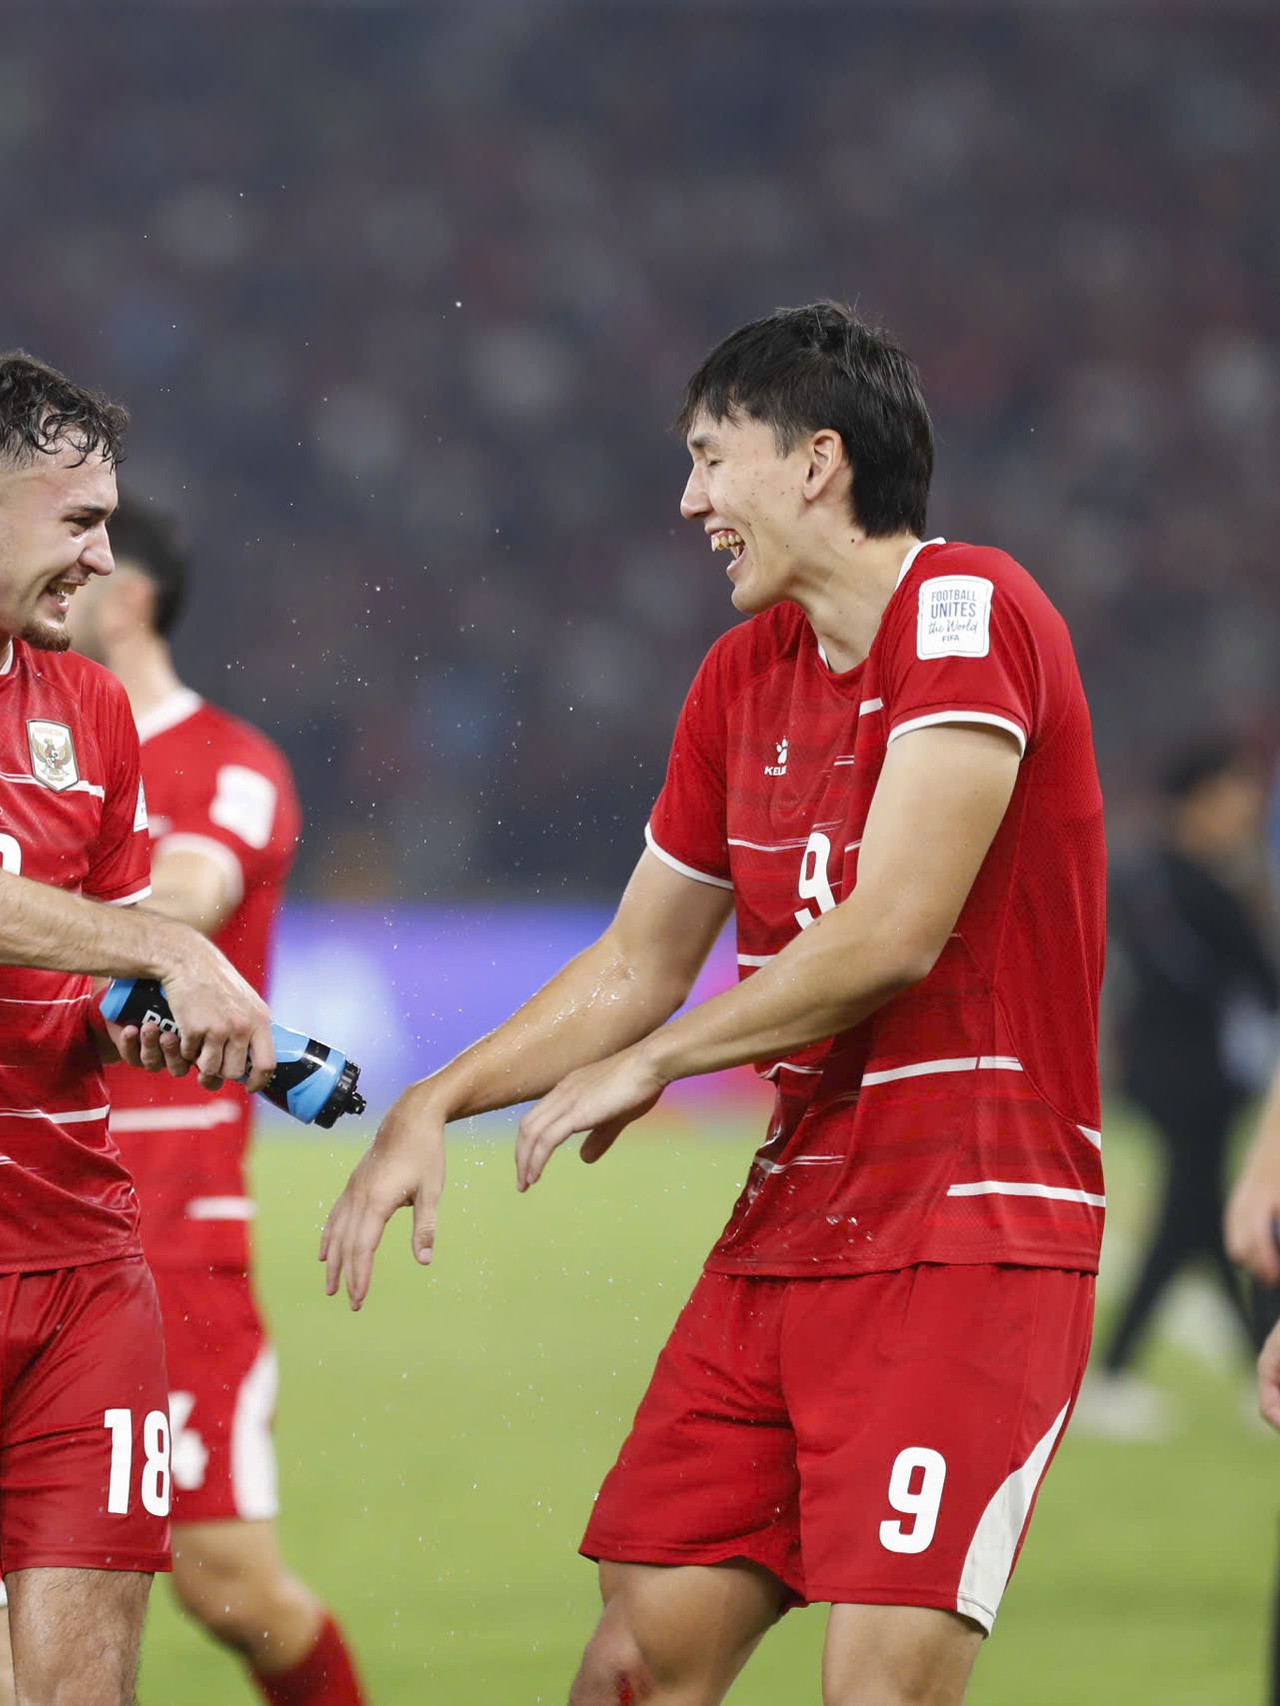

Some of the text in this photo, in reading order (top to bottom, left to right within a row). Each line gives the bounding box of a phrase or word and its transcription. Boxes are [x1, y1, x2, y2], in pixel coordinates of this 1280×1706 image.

[931, 588, 977, 602] FOOTBALL
[930, 602, 976, 619] UNITES
[946, 618, 979, 634] World
[942, 634, 960, 643] FIFA
[794, 832, 837, 930] 9
[104, 1408, 171, 1517] 18
[879, 1446, 947, 1554] 9
